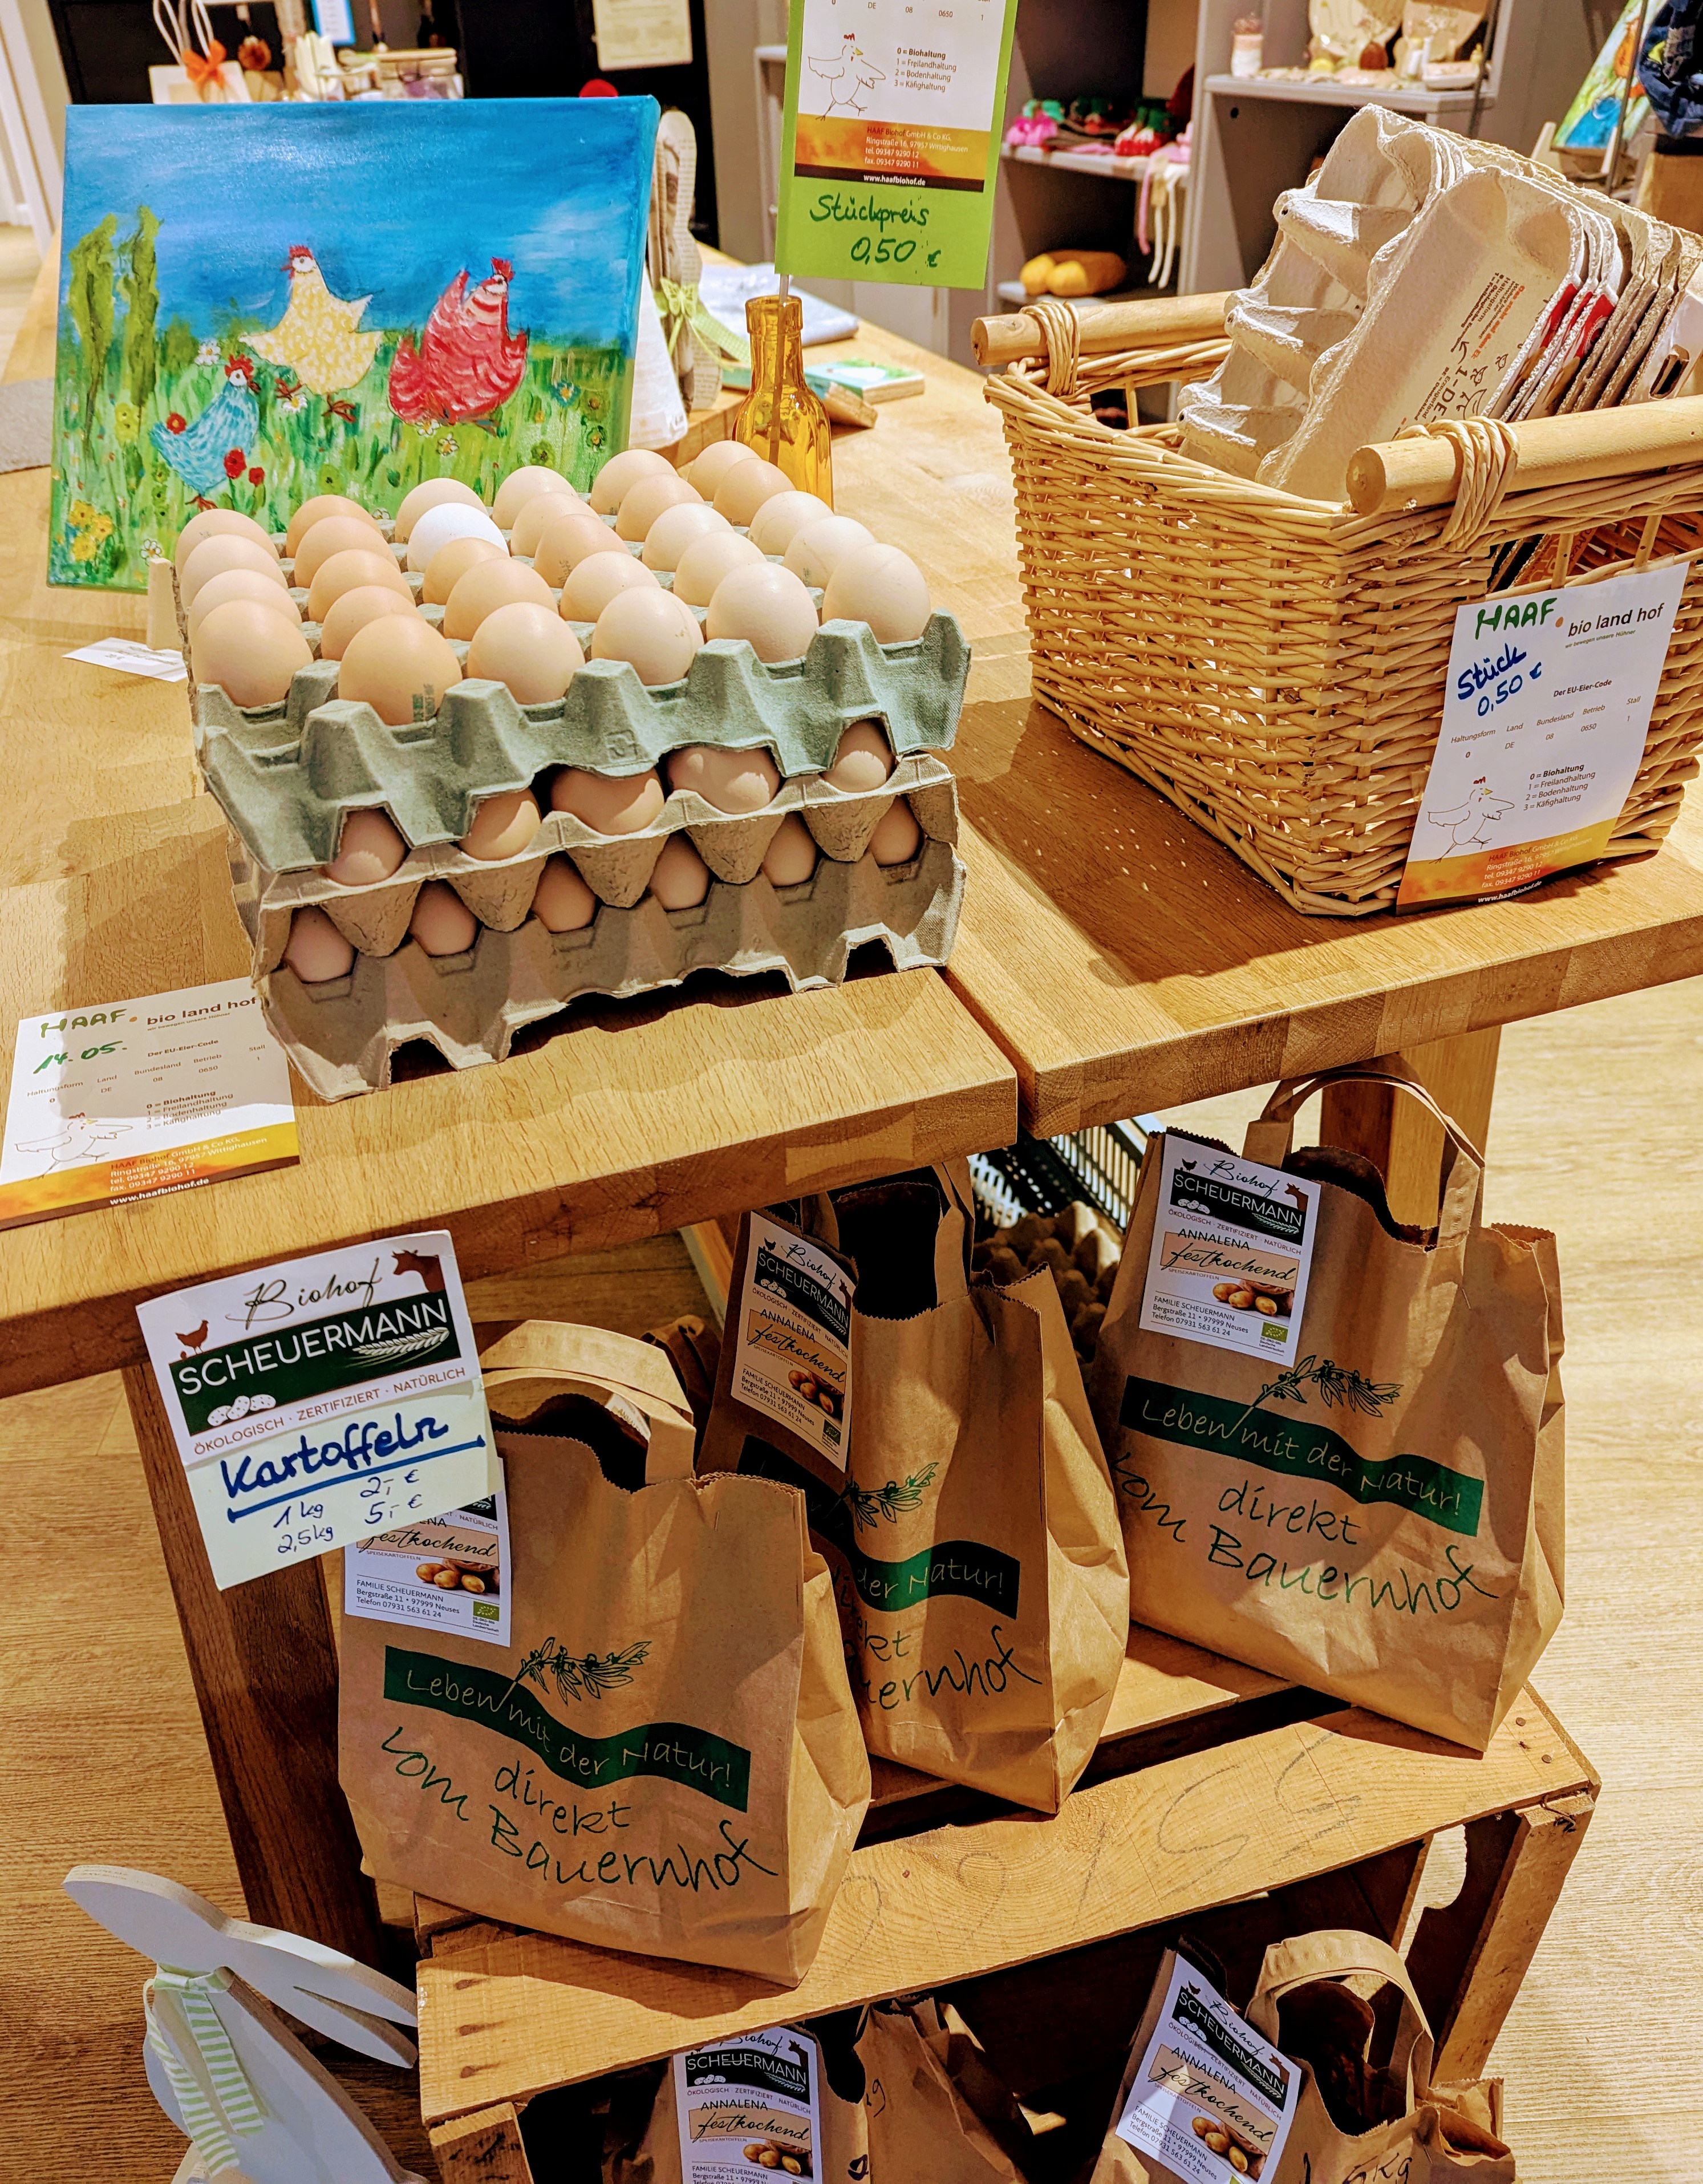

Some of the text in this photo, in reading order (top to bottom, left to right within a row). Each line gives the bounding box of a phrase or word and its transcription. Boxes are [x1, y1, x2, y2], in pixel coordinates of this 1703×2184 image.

[907, 59, 956, 72] Freilandhaltung
[909, 48, 946, 60] Biohaltung
[906, 81, 946, 92] Käfighaltung
[907, 70, 951, 82] Bodenhaltung
[866, 137, 898, 147] Ringstraße
[863, 175, 926, 186] www.haafbiohof.de
[810, 193, 929, 232] Stückpreis
[850, 237, 916, 265] 0,50
[1475, 597, 1558, 640] HAAF
[1568, 603, 1665, 637] bio land hof
[1458, 643, 1527, 700] Stück
[1567, 679, 1612, 694] EU-Eier-Code
[1478, 675, 1523, 716] 0,50
[1451, 696, 1640, 743] Haltungsform Land Bundesland Betrieb Stall
[1581, 723, 1596, 732] 0650
[1540, 772, 1595, 788] Freilandhaltung
[1543, 764, 1584, 777] Biohaltung
[1536, 794, 1581, 808] Käfighaltung
[1539, 783, 1588, 799] Bodenhaltung
[1486, 859, 1522, 870] Ringstraße
[1489, 852, 1509, 862] HAAF
[1510, 848, 1531, 857] Biohof
[1532, 843, 1554, 852] GmbH
[1495, 877, 1515, 886] 09347
[1497, 869, 1515, 877] 09347
[1478, 881, 1542, 903] www.haafbiohof.de
[40, 1008, 127, 1038] HAAF
[147, 997, 257, 1025] bio land hof
[164, 1040, 218, 1053] EU-Eier-Code
[27, 1081, 83, 1097] Haltungsform
[134, 1062, 181, 1075] Bundesland
[193, 1054, 222, 1063] Betrieb
[164, 1091, 216, 1105] Biohaltung
[164, 1093, 233, 1112] Freilandhaltung
[110, 1178, 209, 1205] www.haafbiohof.de
[1203, 1160, 1280, 1197] Biohof
[1174, 1174, 1302, 1226] SCHEUERMANN
[1168, 1209, 1301, 1255] ÖKOLOGISCH ZERTIFIZIERT NATÜRLICH
[1178, 1228, 1250, 1250] ANNALENA
[781, 1243, 837, 1291] Biohof
[1161, 1242, 1296, 1281] festkochend
[225, 1257, 383, 1330] Biohof
[758, 1253, 849, 1328] SCHEUERMANN
[752, 1287, 821, 1334] ÖKOLOGISCH ZERTIFIZIERT
[1152, 1312, 1174, 1322] Telefon
[1175, 1317, 1195, 1328] 07931
[1153, 1304, 1248, 1333] Bergstraße 97999 Neuses
[1154, 1295, 1235, 1320] FAMILIE SCHEUERMANN
[760, 1308, 816, 1343] ANNALENA
[177, 1299, 447, 1396] SCHEUERMANN
[748, 1324, 845, 1383] festkochend
[741, 1376, 768, 1395] Bergstraße
[741, 1383, 776, 1407] Telefon 07931
[743, 1368, 805, 1411] FAMILIE SCHEUERMANN
[194, 1367, 466, 1455] ÖKOLOGISCH ZERTIFIZIERT NATÜRLICH
[220, 1412, 449, 1499] Kartoffeln
[1142, 1400, 1461, 1516] Leben mit der Natur!
[404, 1469, 420, 1484] €
[407, 1494, 423, 1509] €
[1219, 1480, 1362, 1545] direkt
[459, 1516, 498, 1530] NATÜRLICH
[910, 1559, 1003, 1594] Natur!
[1208, 1524, 1499, 1615] Bauernhof
[356, 1597, 381, 1606] Telefon
[383, 1601, 404, 1611] 07931
[357, 1580, 443, 1601] FAMILIE SCHEUERMANN
[357, 1588, 460, 1614] Bergstraße 97999 Neuses
[508, 1704, 731, 1787] mit der Natur!
[495, 1760, 632, 1837] direkt
[488, 1805, 778, 1892] Bauernhof
[1205, 1995, 1265, 2056] Biohof
[1179, 1992, 1284, 2093] SCHEUERMANN
[687, 2054, 806, 2085] SCHEUERMANN
[1171, 2047, 1236, 2094] ANNALENA
[687, 2087, 811, 2114] ÖKOLOGISCH ZERTIFIZIERT NATÜRLICH
[701, 2100, 768, 2110] ANNALENA
[1148, 2065, 1274, 2145] festkochend
[1250, 2089, 1282, 2121] NATÜRLICH
[692, 2112, 809, 2143] festkochend
[1130, 2121, 1169, 2152] Telefon 07931
[1135, 2106, 1207, 2161] FAMILIE SCHEUERMANN
[1132, 2113, 1217, 2180] Bergstraße 97999 Neuses
[719, 2167, 768, 2179] SCHEUERMANN
